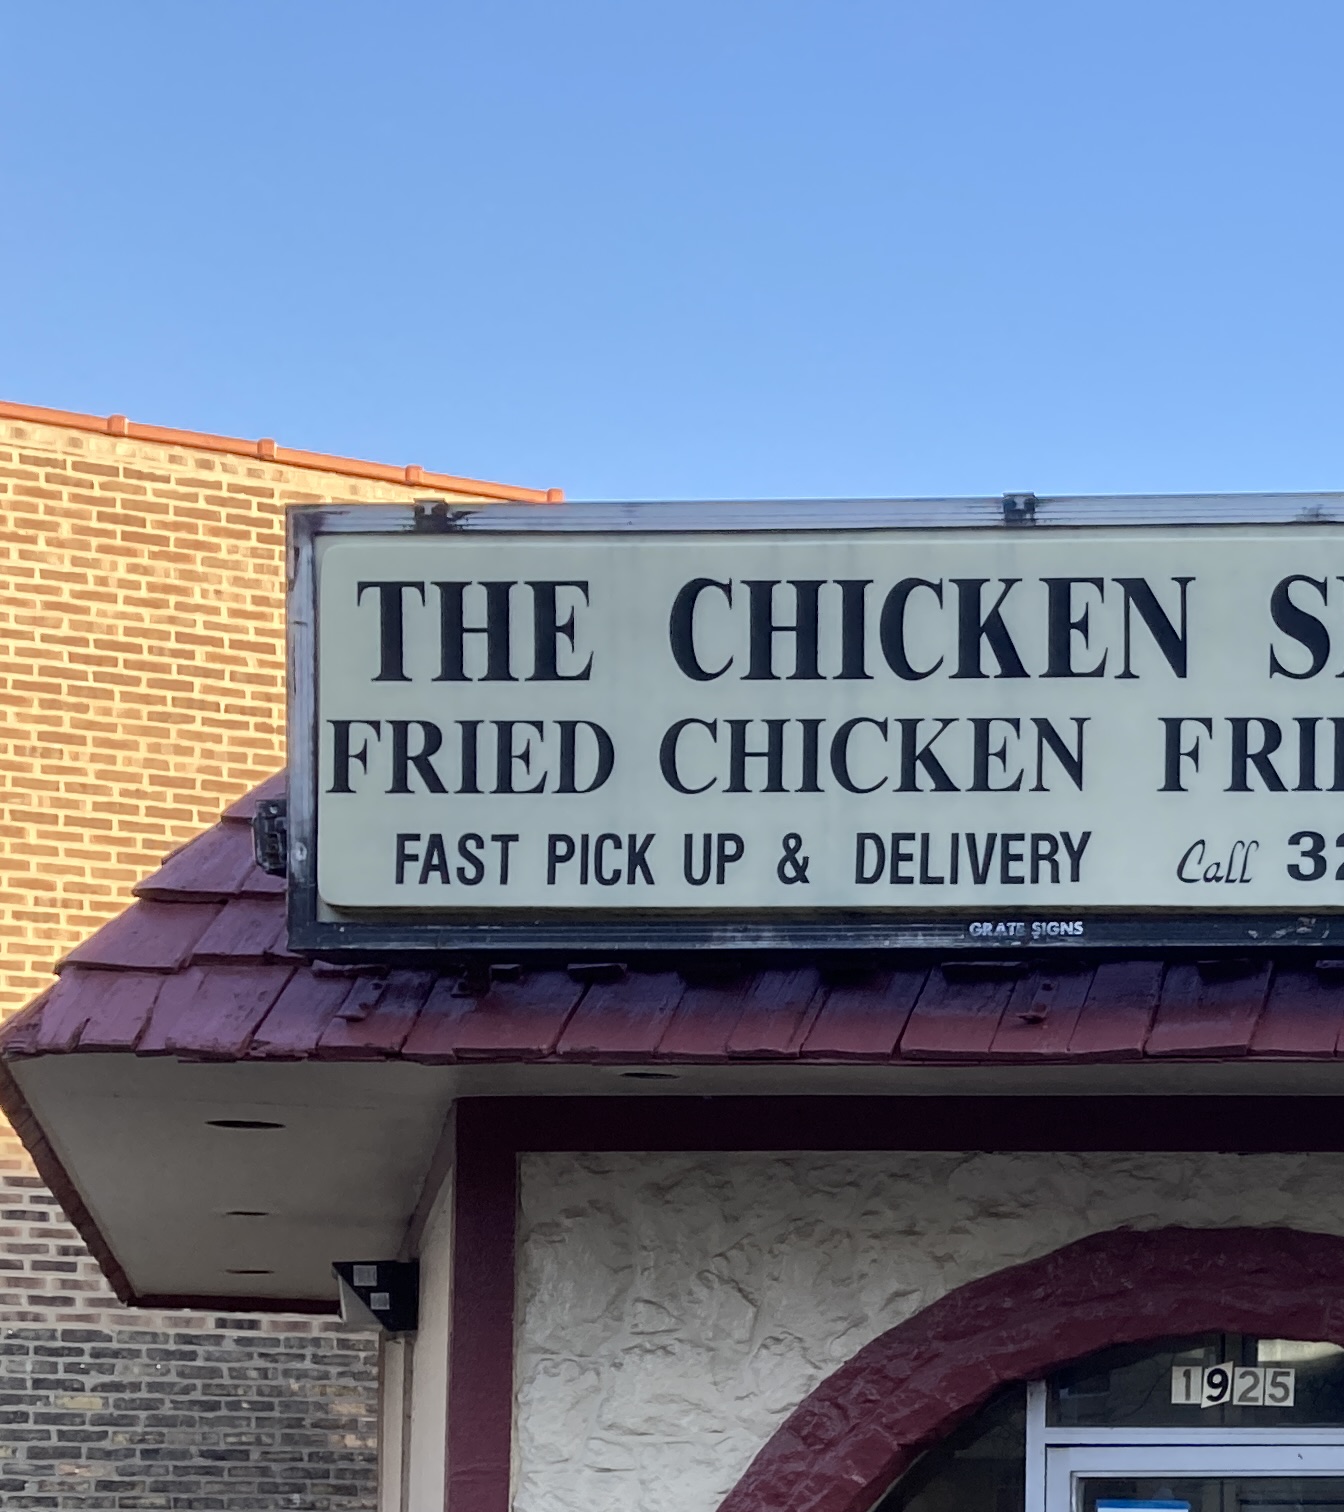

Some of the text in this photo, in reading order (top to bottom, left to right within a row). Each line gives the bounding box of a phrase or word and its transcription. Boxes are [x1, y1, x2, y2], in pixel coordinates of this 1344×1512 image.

[357, 580, 594, 682] THE
[669, 576, 1197, 681] CHICKEN
[326, 719, 615, 795] FRIED
[659, 716, 1092, 794] CHICKEN
[395, 833, 519, 886] FAST
[547, 833, 656, 886] PICK
[684, 833, 744, 886] UP
[777, 833, 811, 886] &
[855, 831, 1092, 885] DELIVERY
[1176, 839, 1260, 884] Call
[968, 921, 1084, 938] GRATE SIGNS
[1182, 1367, 1291, 1403] 1925
